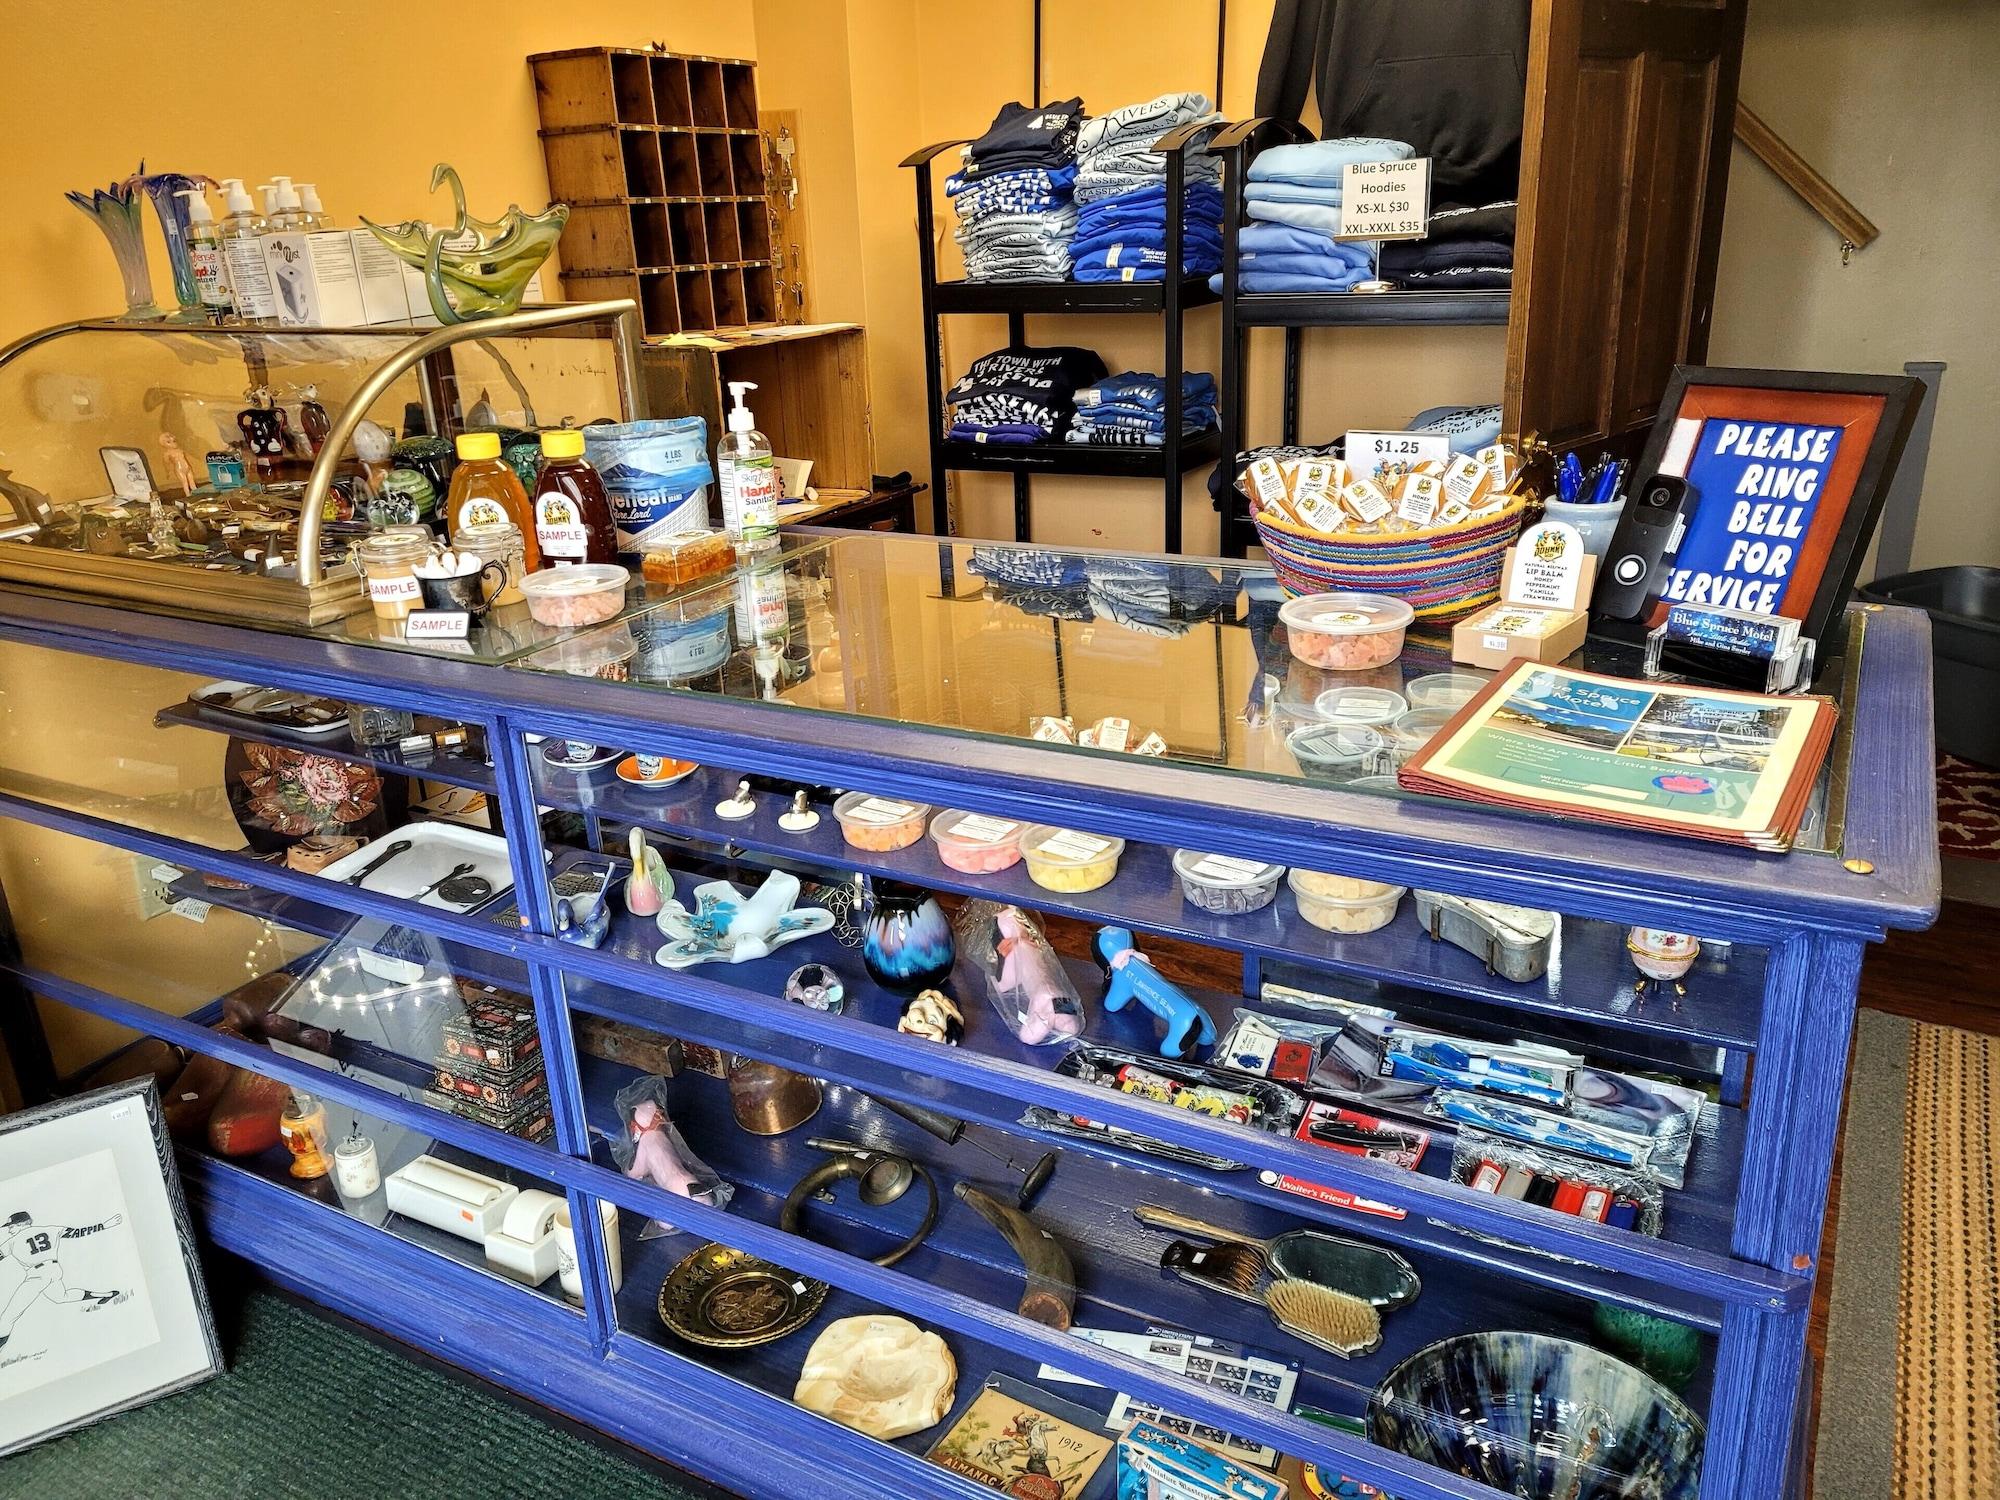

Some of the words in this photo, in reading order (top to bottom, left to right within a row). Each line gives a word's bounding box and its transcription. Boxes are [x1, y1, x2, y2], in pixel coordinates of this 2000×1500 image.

[1352, 163, 1376, 174] Blue
[1379, 162, 1417, 174] Spruce
[1361, 181, 1406, 194] Hoodies
[1356, 203, 1386, 214] XS-XL
[1389, 201, 1409, 213] $30
[1345, 222, 1396, 234] XXL-XXXL
[1399, 221, 1419, 232] $35
[997, 356, 1029, 368] TOWN
[1032, 357, 1062, 369] WITH
[1375, 439, 1419, 453] $1.25
[1714, 424, 1836, 463] PLEASE
[740, 482, 772, 497] Hand
[1735, 464, 1819, 501] RING
[1727, 500, 1804, 539] BELL
[539, 530, 582, 541] SAMPLE
[1724, 539, 1792, 578] FOR
[1541, 569, 1564, 578] BALM
[370, 582, 416, 595] SAMPLE
[1525, 582, 1560, 590] PEPPERMINT
[411, 620, 463, 630] SAMPLE
[1674, 612, 1698, 627] Blue
[1702, 618, 1739, 635] Spruce
[1743, 626, 1773, 642] Motel
[1552, 691, 1608, 709] Motel
[1488, 733, 1524, 745] Where
[1527, 742, 1545, 751] We
[1547, 748, 1568, 756] Are
[1614, 757, 1646, 769] Little
[1282, 1181, 1318, 1197] Waiter's
[1320, 1191, 1350, 1205] Friend
[26, 1232, 51, 1255] 13
[1058, 1436, 1083, 1452] 1912
[944, 1457, 997, 1488] ALMANAC
[1144, 1461, 1177, 1485] Miniature
